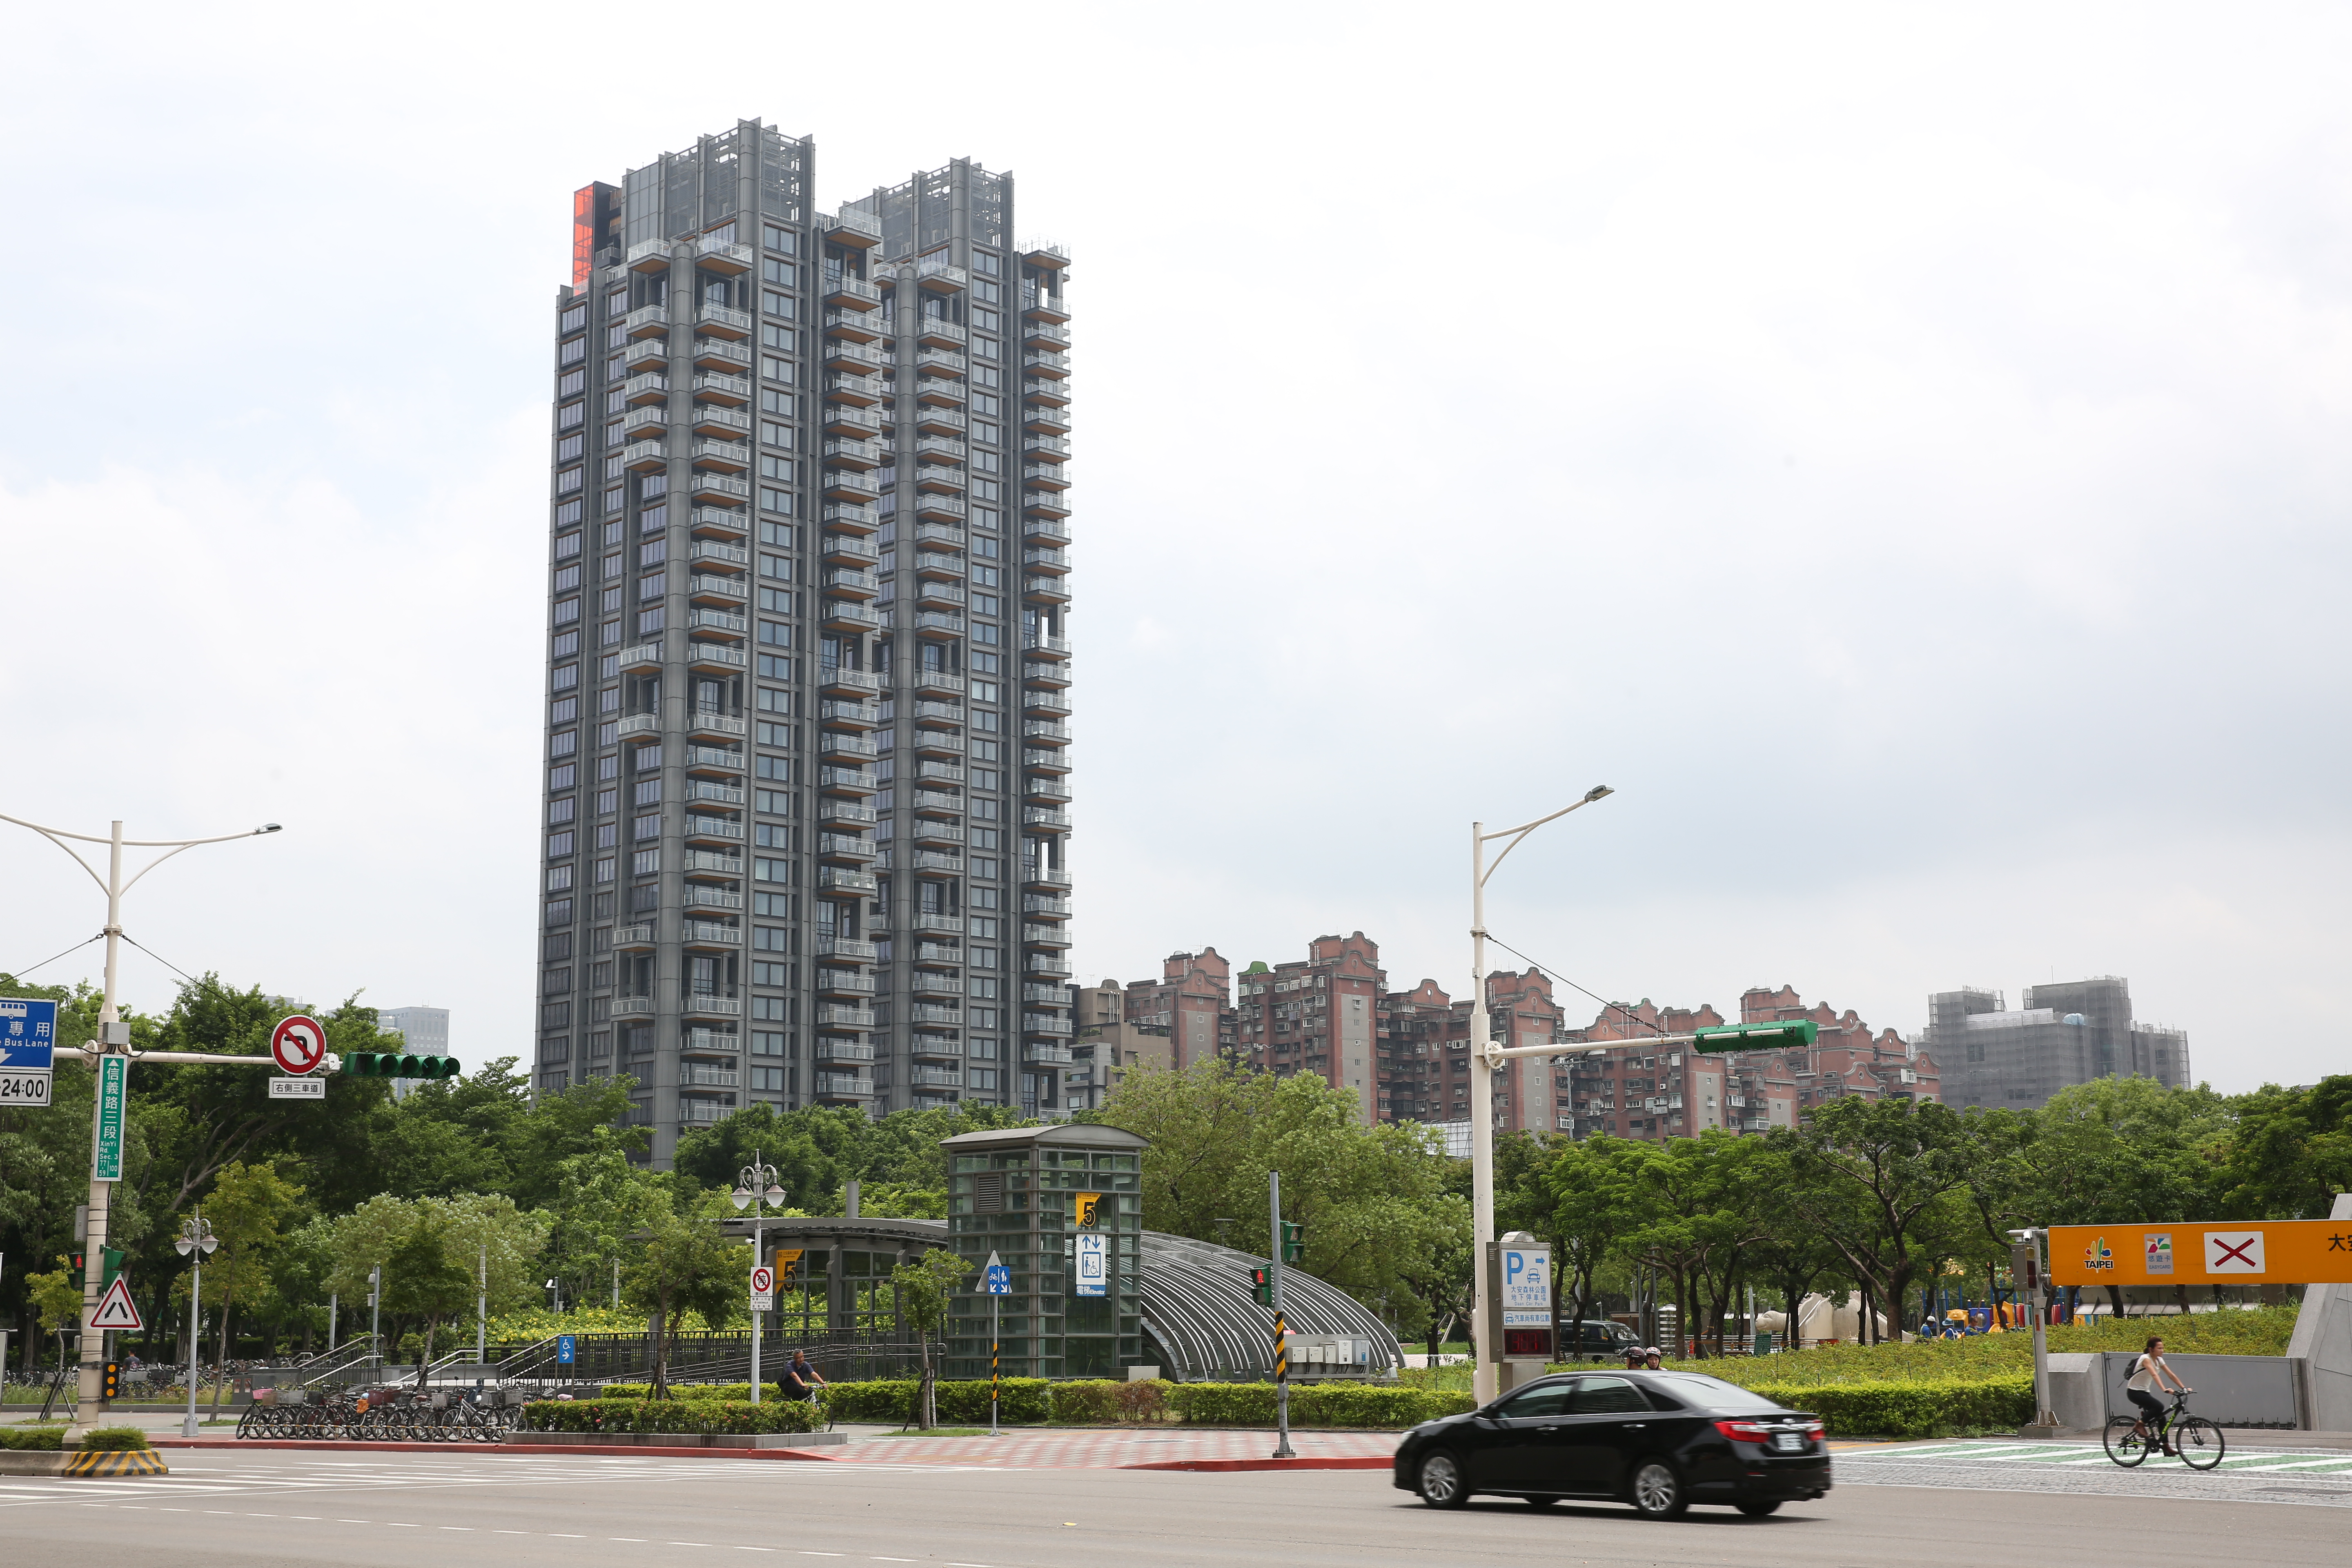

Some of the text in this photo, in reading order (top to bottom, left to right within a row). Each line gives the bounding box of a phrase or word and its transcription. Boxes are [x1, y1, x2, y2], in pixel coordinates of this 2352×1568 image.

[25, 1039, 48, 1047] Lane
[276, 1084, 318, 1092] 右側三車道
[104, 1067, 120, 1139] 信義路三段
[1083, 1202, 1095, 1226] 5
[2328, 1233, 2352, 1252] 大
[1507, 1252, 1523, 1285] P
[2084, 1261, 2113, 1269] TAIPEI
[783, 1261, 796, 1293] 5
[1077, 1285, 1090, 1295] 電梯
